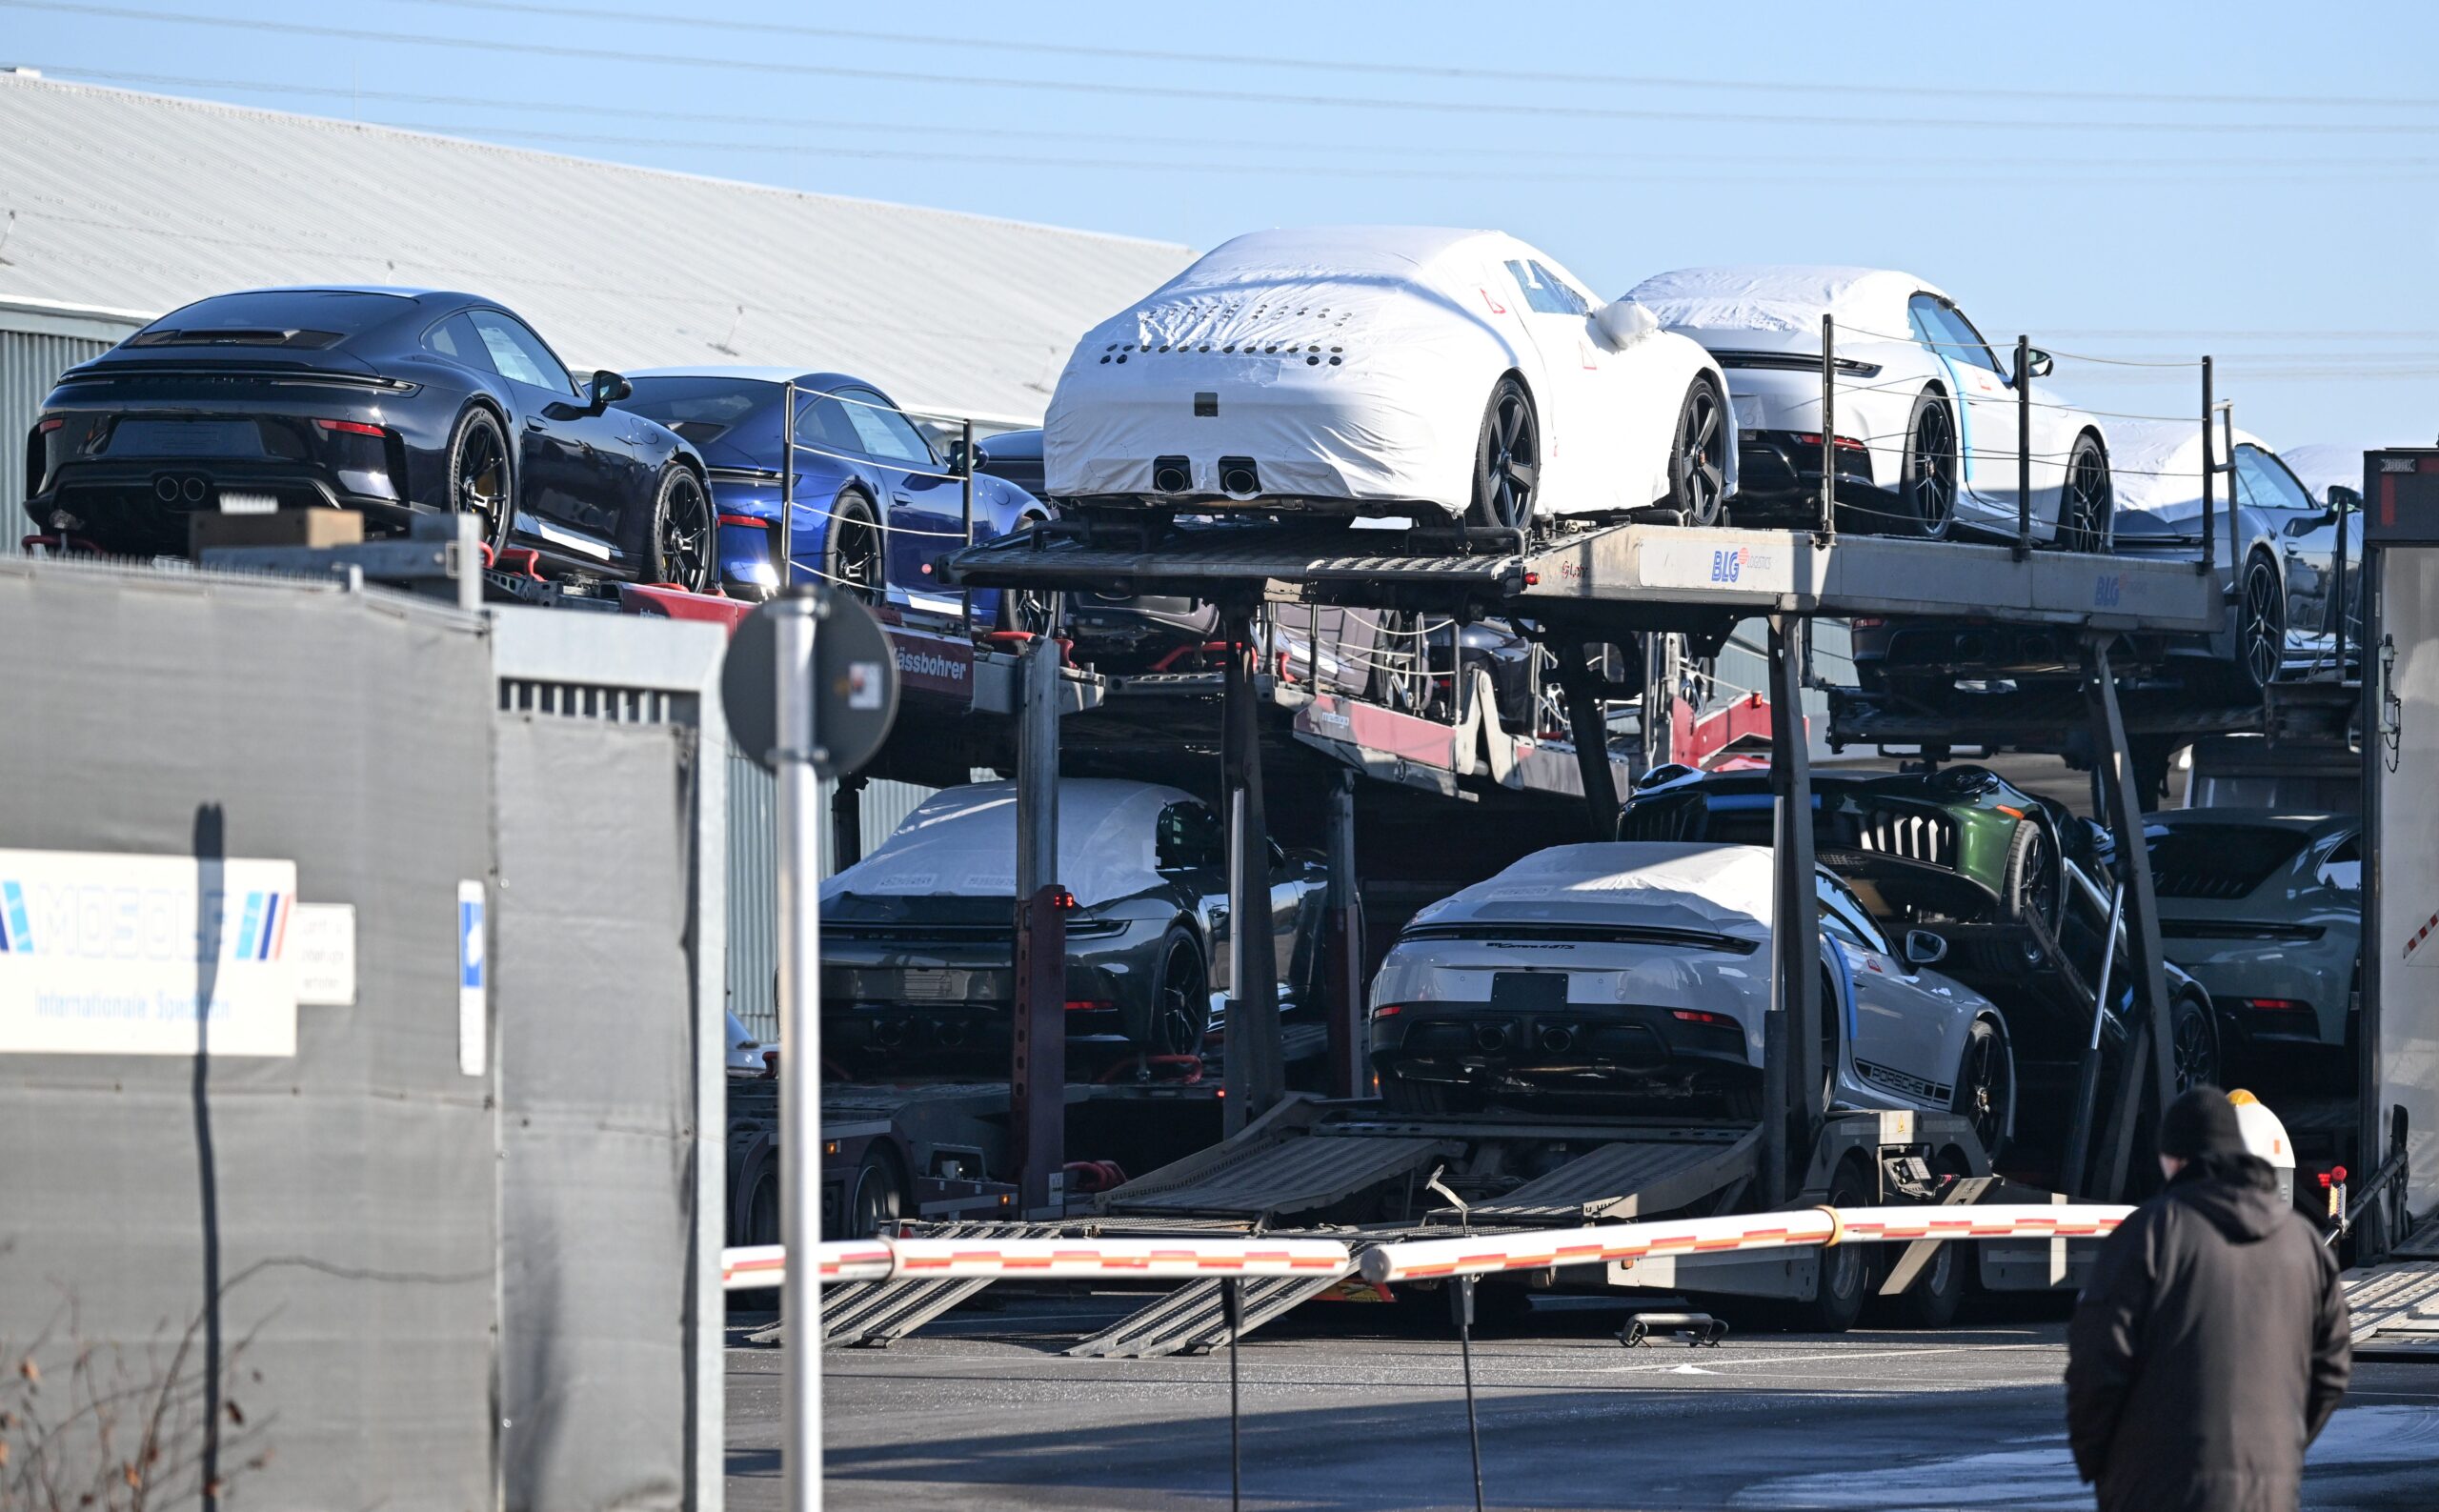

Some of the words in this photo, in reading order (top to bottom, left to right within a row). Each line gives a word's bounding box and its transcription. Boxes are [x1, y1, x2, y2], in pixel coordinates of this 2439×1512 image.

[1712, 551, 1740, 583] BLG
[2095, 575, 2120, 607] BLG
[1871, 1067, 1924, 1095] PORSCHE
